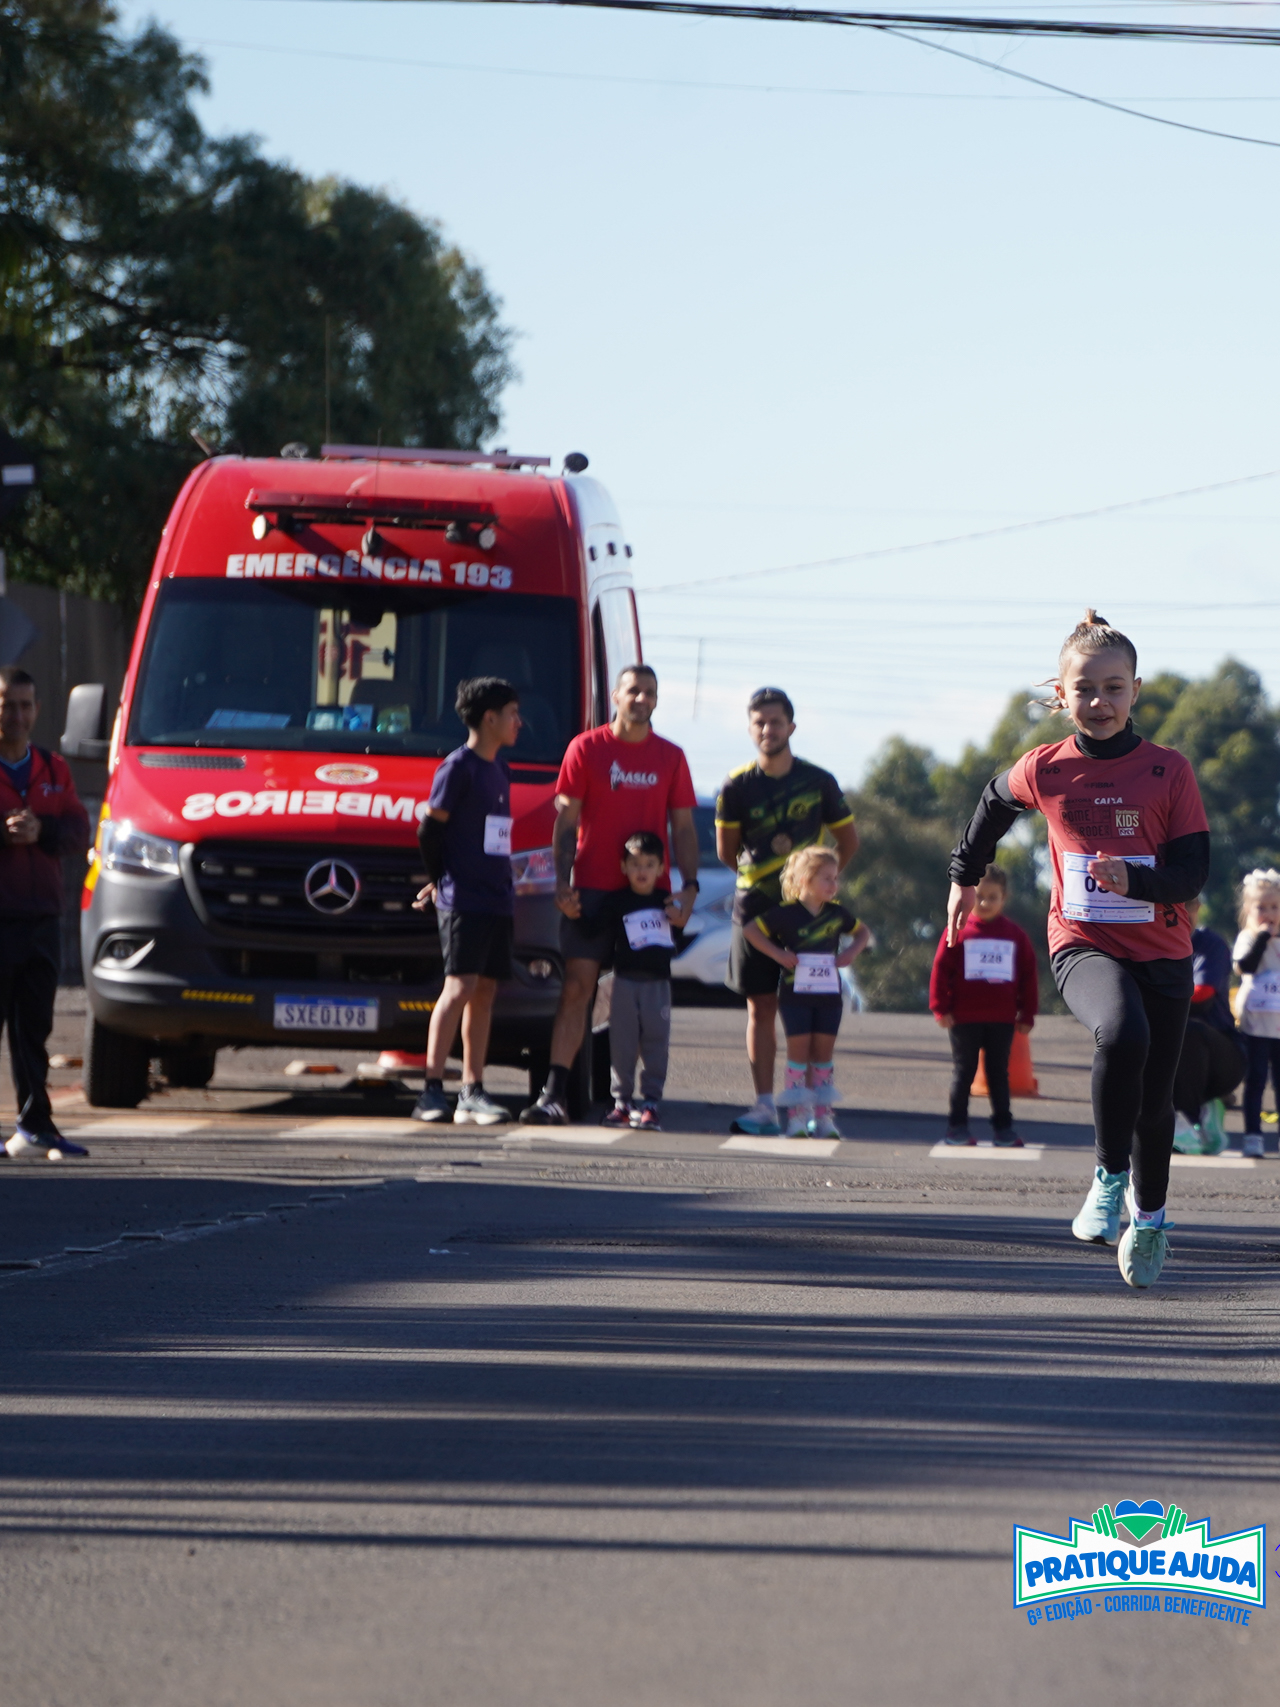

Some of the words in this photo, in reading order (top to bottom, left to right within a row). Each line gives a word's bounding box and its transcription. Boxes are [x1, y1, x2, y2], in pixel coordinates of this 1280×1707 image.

[226, 550, 442, 582] EMERGÊNCIA
[450, 561, 512, 589] 193
[1094, 796, 1124, 805] CAIXA
[1115, 814, 1140, 828] KIDS
[809, 967, 831, 977] 226
